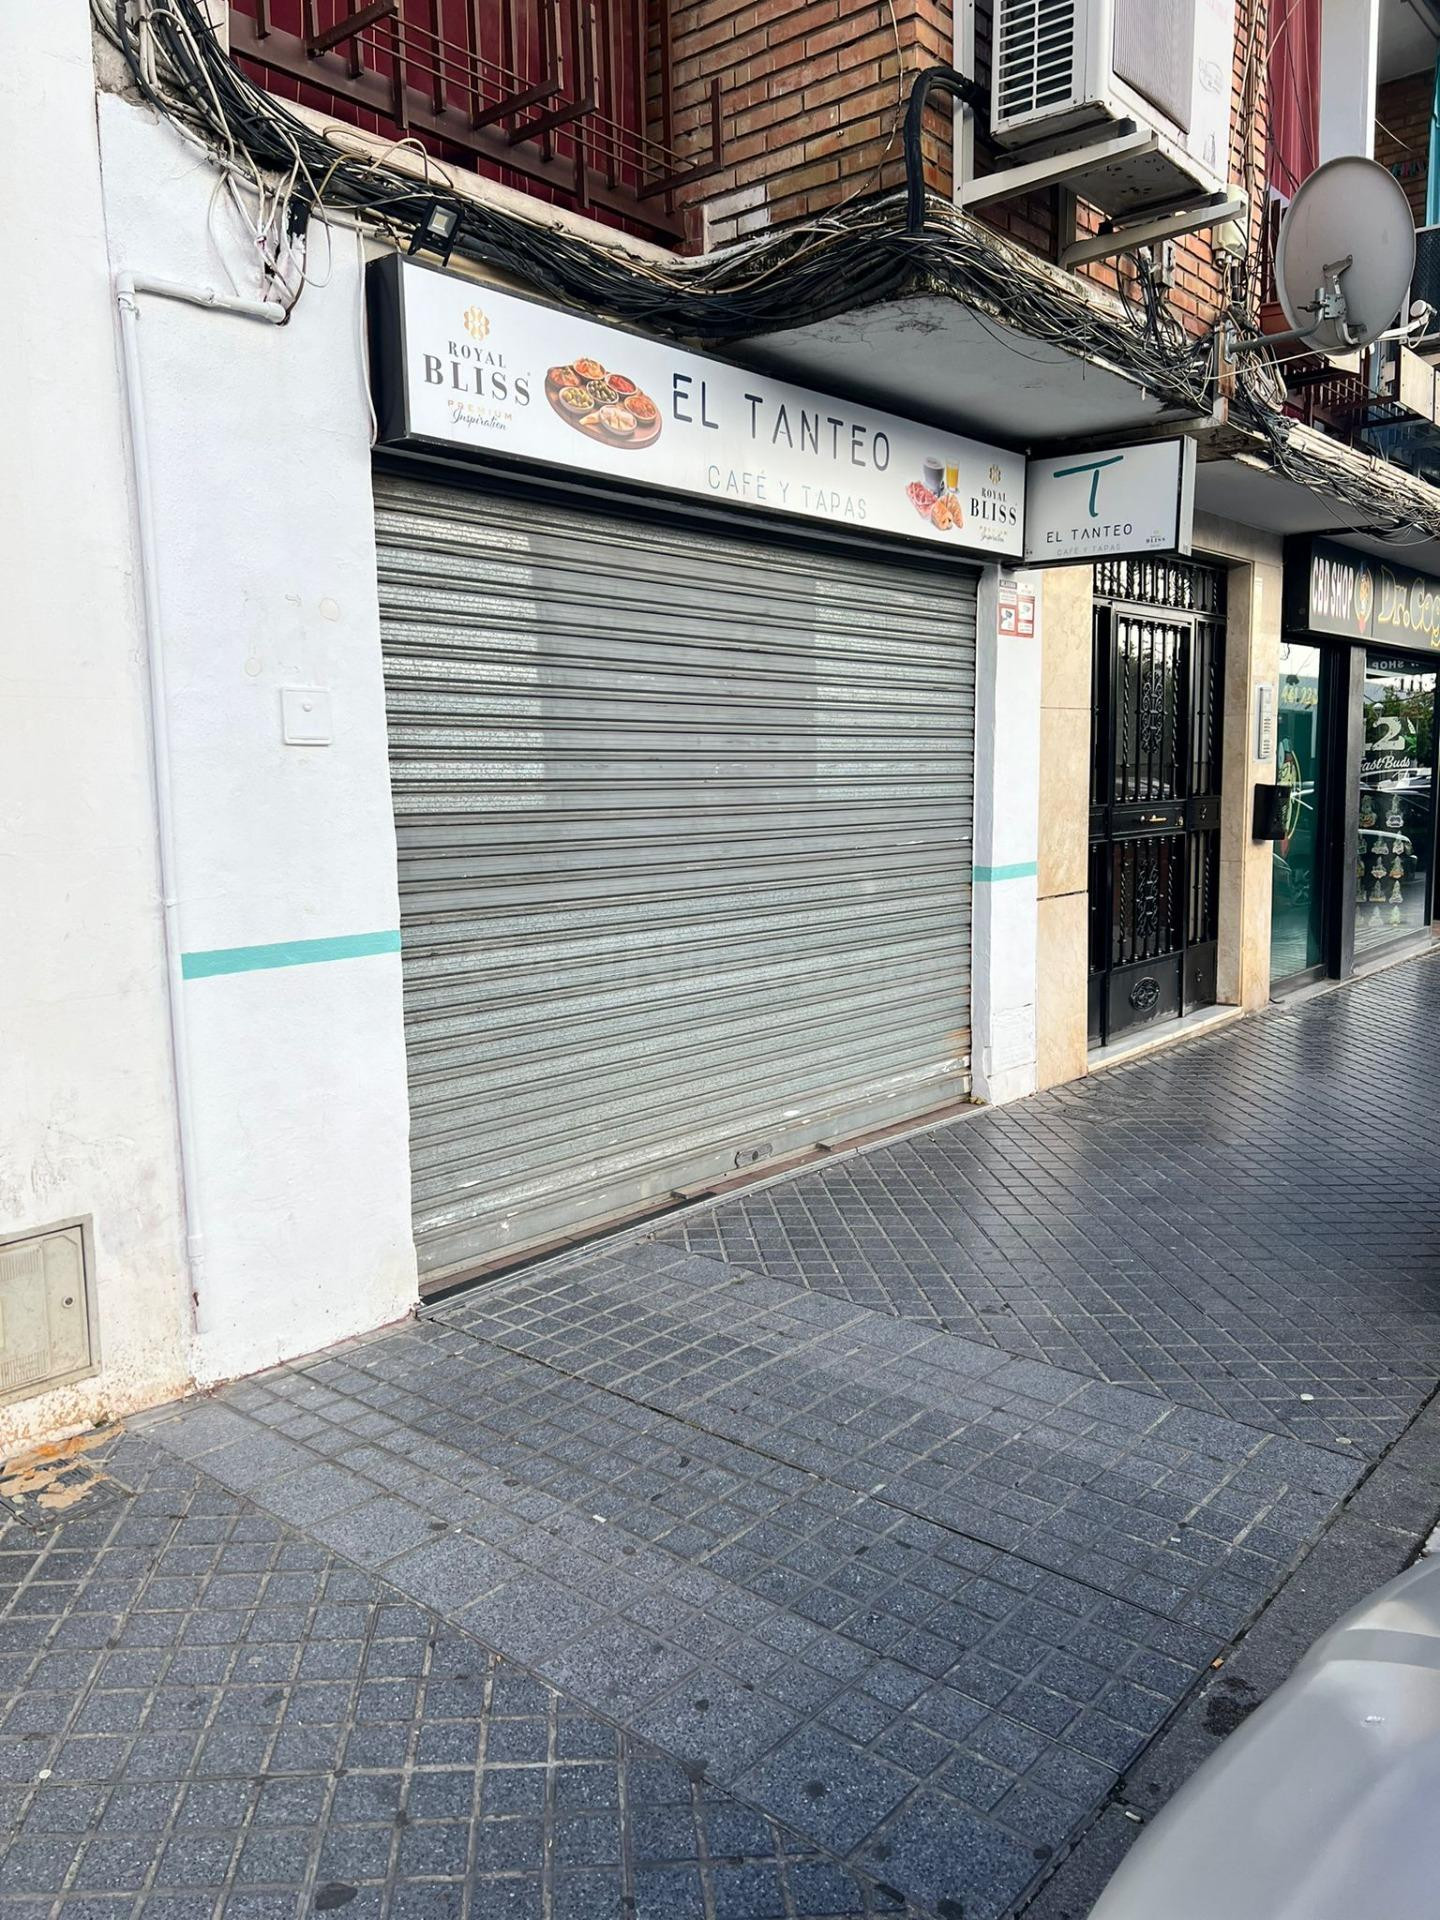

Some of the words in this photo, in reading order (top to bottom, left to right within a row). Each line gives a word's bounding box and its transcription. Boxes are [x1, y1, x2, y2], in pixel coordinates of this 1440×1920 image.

[448, 340, 506, 368] ROYAL
[423, 353, 531, 406] BLISS
[450, 406, 506, 431] Inspiration
[673, 372, 719, 429] EL
[744, 393, 890, 471] TANTEO
[708, 465, 767, 500] CAFÉ
[778, 481, 790, 503] Y
[801, 485, 867, 520] TAPAS
[981, 488, 1007, 502] ROYAL
[970, 497, 1017, 526] BLISS
[1046, 531, 1063, 544] EL
[1071, 523, 1133, 541] TANTEO
[1312, 556, 1330, 614] CBD
[1330, 562, 1354, 620] SHOP
